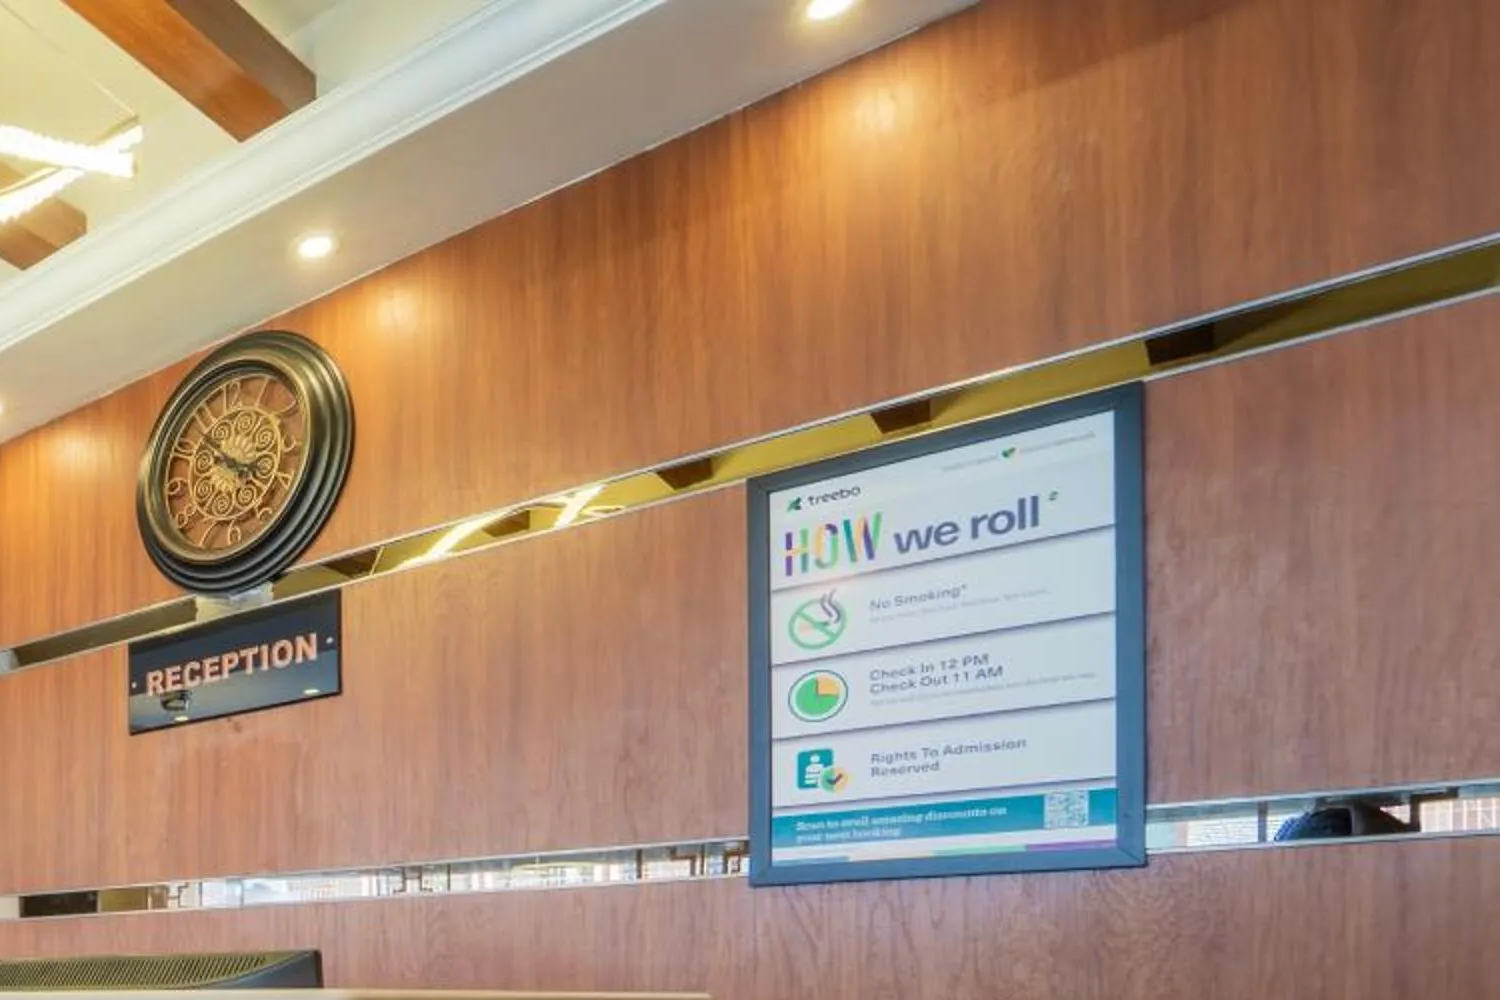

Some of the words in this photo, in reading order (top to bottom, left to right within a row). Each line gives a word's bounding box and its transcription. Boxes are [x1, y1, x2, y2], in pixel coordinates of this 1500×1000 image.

[807, 485, 861, 508] treebo
[785, 511, 883, 577] HOW
[893, 519, 959, 555] we
[971, 495, 1040, 541] roll
[870, 598, 891, 611] No
[146, 632, 318, 697] RECEPTION
[870, 664, 916, 682] Check
[921, 662, 935, 673] In
[940, 659, 959, 670] 12
[962, 653, 990, 667] PM
[870, 677, 917, 694] Check
[920, 675, 948, 687] Out
[954, 671, 970, 682] 11
[976, 666, 1003, 679] AM
[871, 749, 917, 765] Rights
[921, 747, 938, 758] To
[943, 738, 1028, 756] Admission
[871, 761, 940, 778] Reserved
[871, 814, 922, 828] amazing
